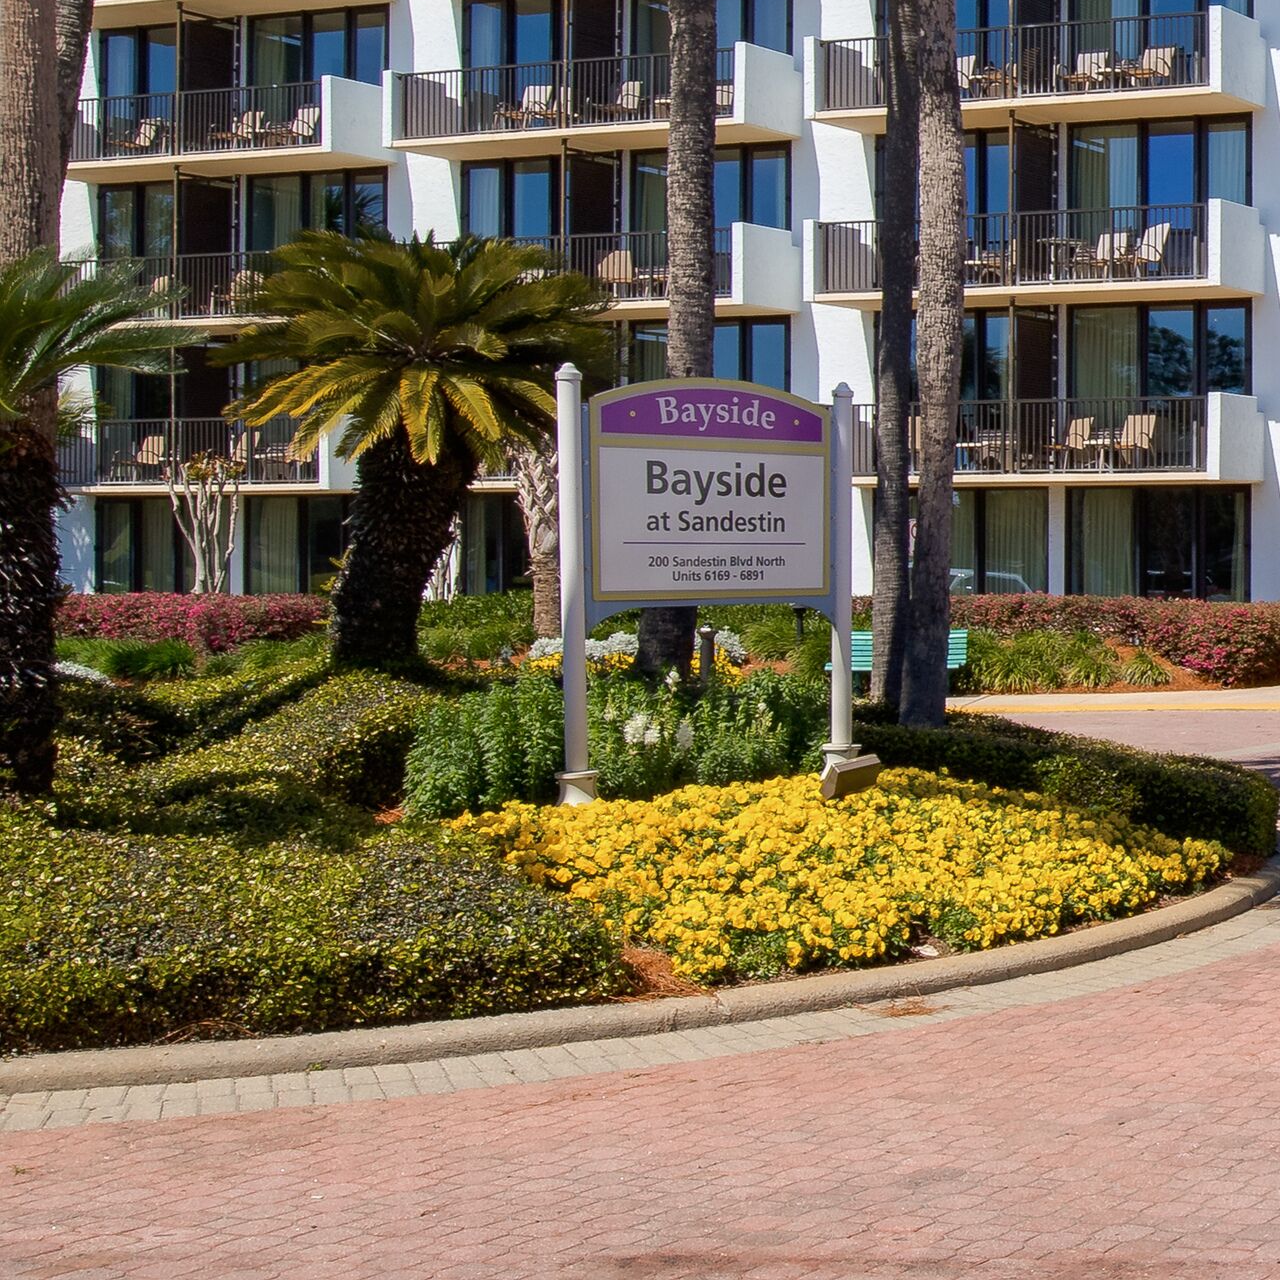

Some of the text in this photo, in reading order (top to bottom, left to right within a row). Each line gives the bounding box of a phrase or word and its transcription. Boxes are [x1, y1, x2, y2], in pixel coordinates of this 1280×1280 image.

[656, 396, 776, 431] Bayside
[645, 460, 787, 505] Bayside
[646, 510, 786, 533] at Sandestin
[648, 556, 785, 567] 200 Sandestin Blvd North
[672, 571, 701, 582] Units
[704, 570, 730, 581] 6169
[740, 570, 764, 580] 6891
